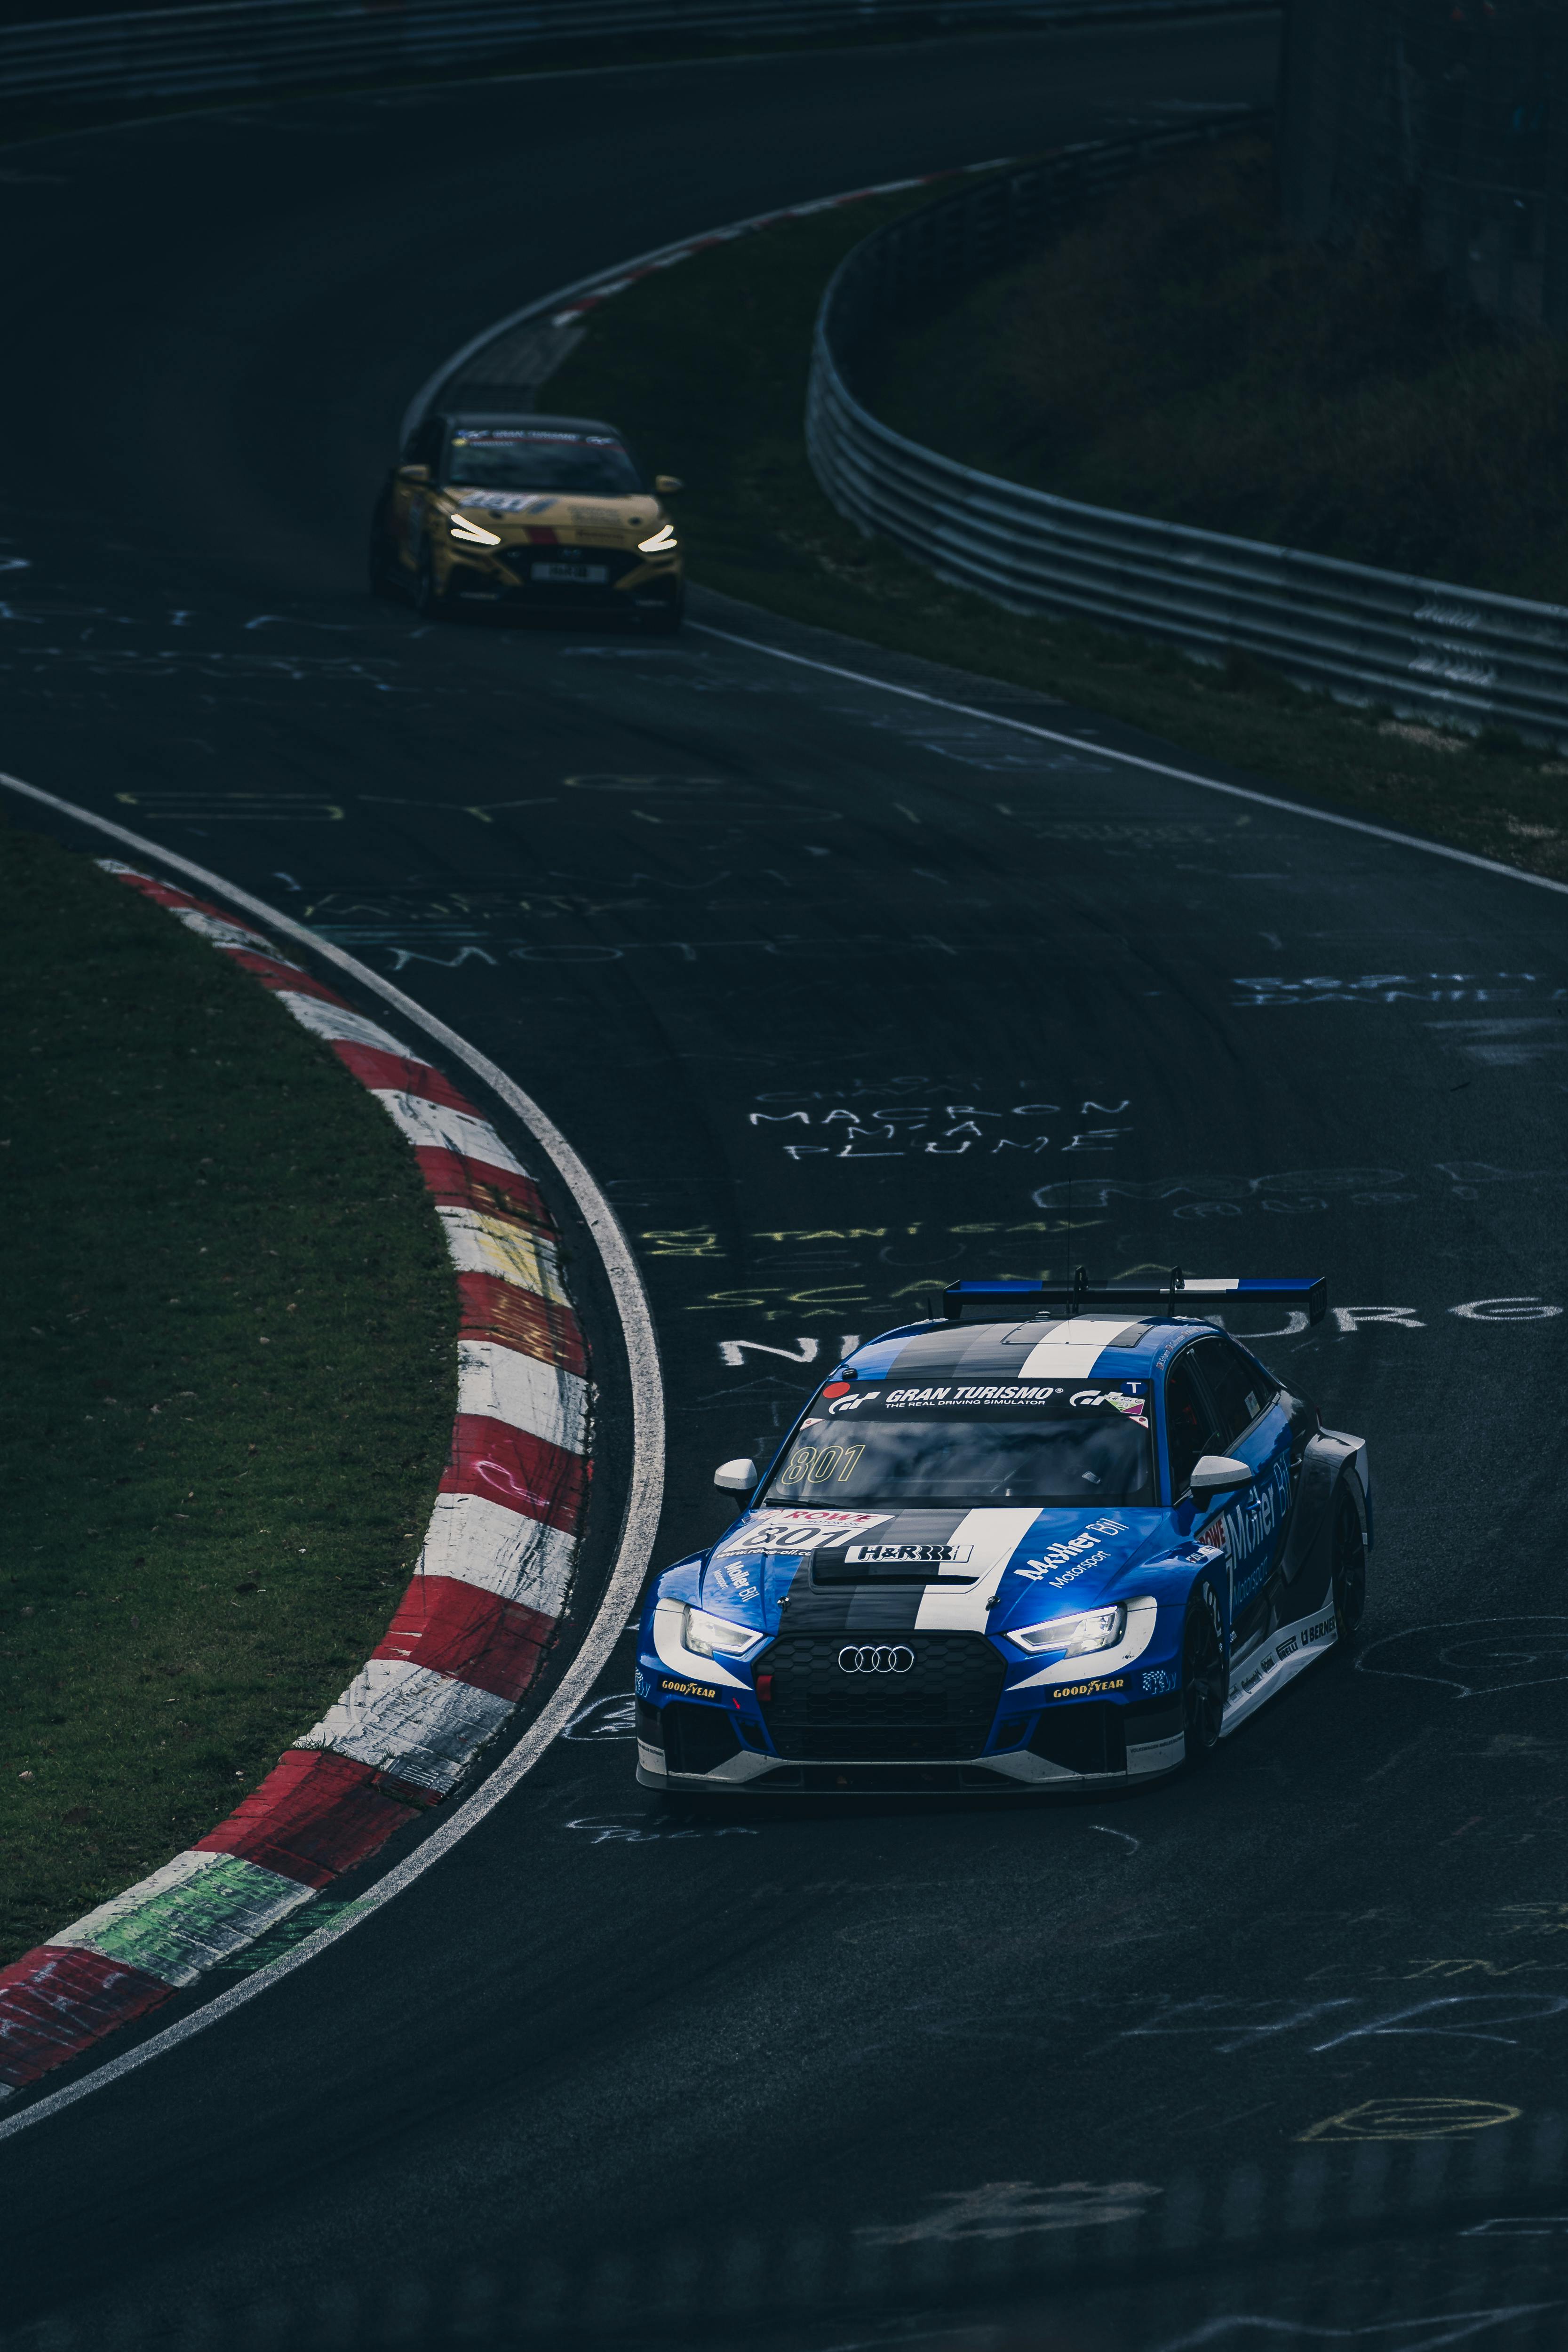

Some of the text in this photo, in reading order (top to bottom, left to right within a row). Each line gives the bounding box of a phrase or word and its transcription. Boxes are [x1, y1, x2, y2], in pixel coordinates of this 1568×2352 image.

[748, 1100, 1130, 1126] MACRON
[885, 1387, 952, 1403] GRAN
[1126, 1382, 1141, 1393] T
[780, 1444, 866, 1485] 801
[783, 1510, 879, 1523] ROWE
[1085, 1518, 1130, 1537] Bil
[742, 1526, 852, 1549] 801
[716, 1549, 812, 1559] www.rowe-oil.co
[1048, 1550, 1112, 1589] Motorsport
[738, 1585, 761, 1603] Bil
[1275, 1635, 1299, 1661] PIRELLI
